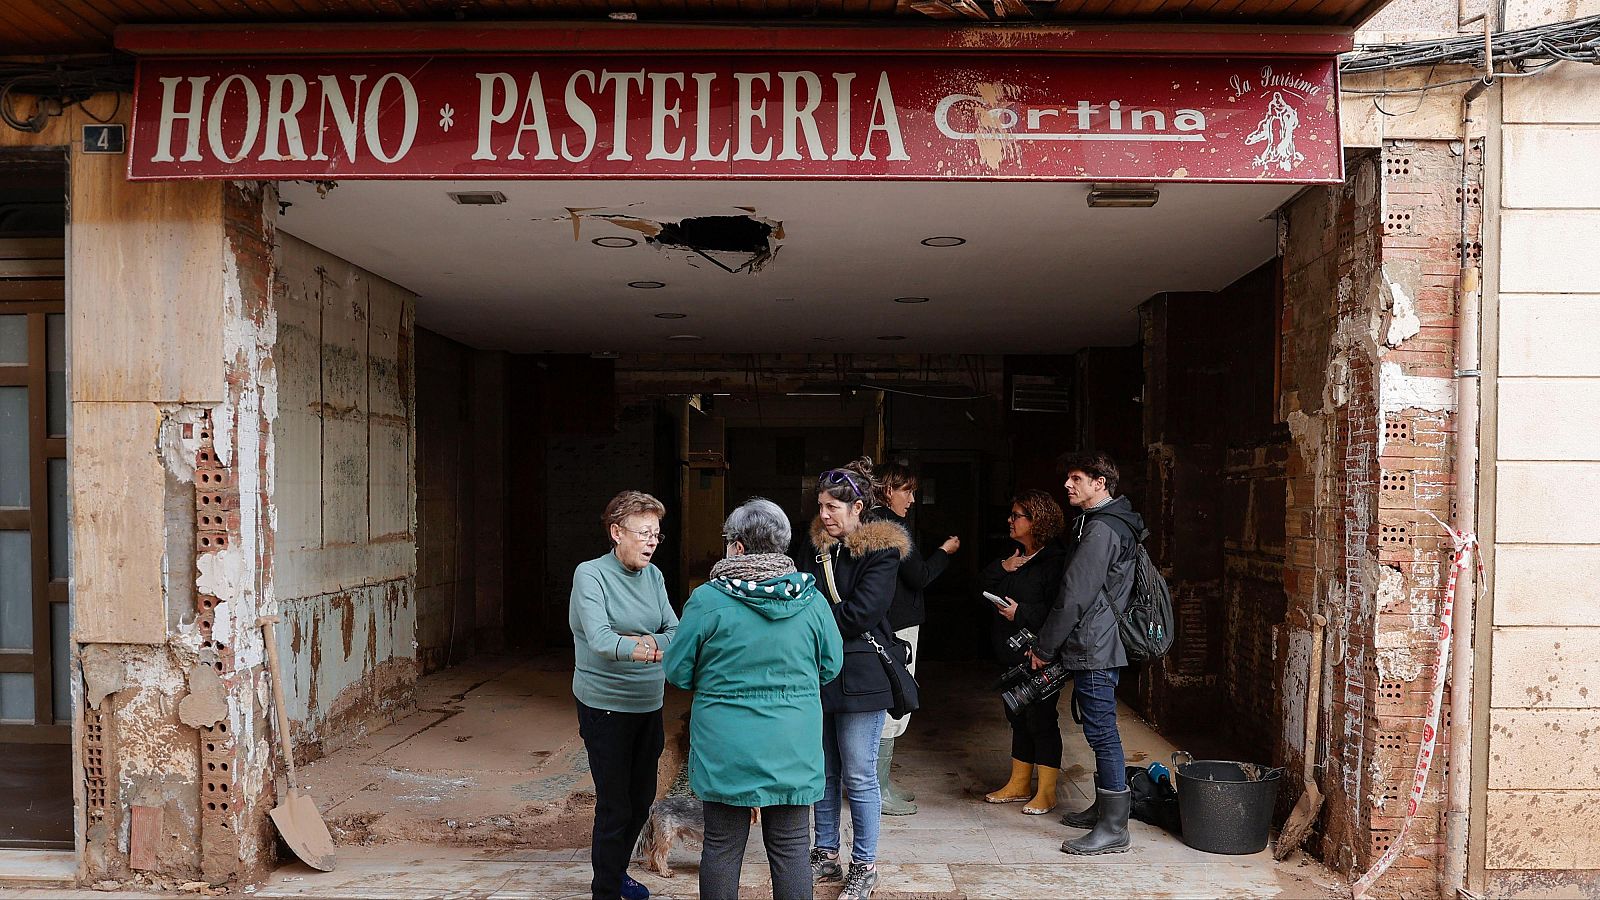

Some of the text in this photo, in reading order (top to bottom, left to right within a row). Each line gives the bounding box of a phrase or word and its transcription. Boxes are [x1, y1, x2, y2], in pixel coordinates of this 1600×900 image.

[1229, 74, 1252, 97] La
[151, 69, 911, 164] HORNO PASTELERIA
[934, 93, 1207, 142] Cortina
[97, 127, 109, 150] 4
